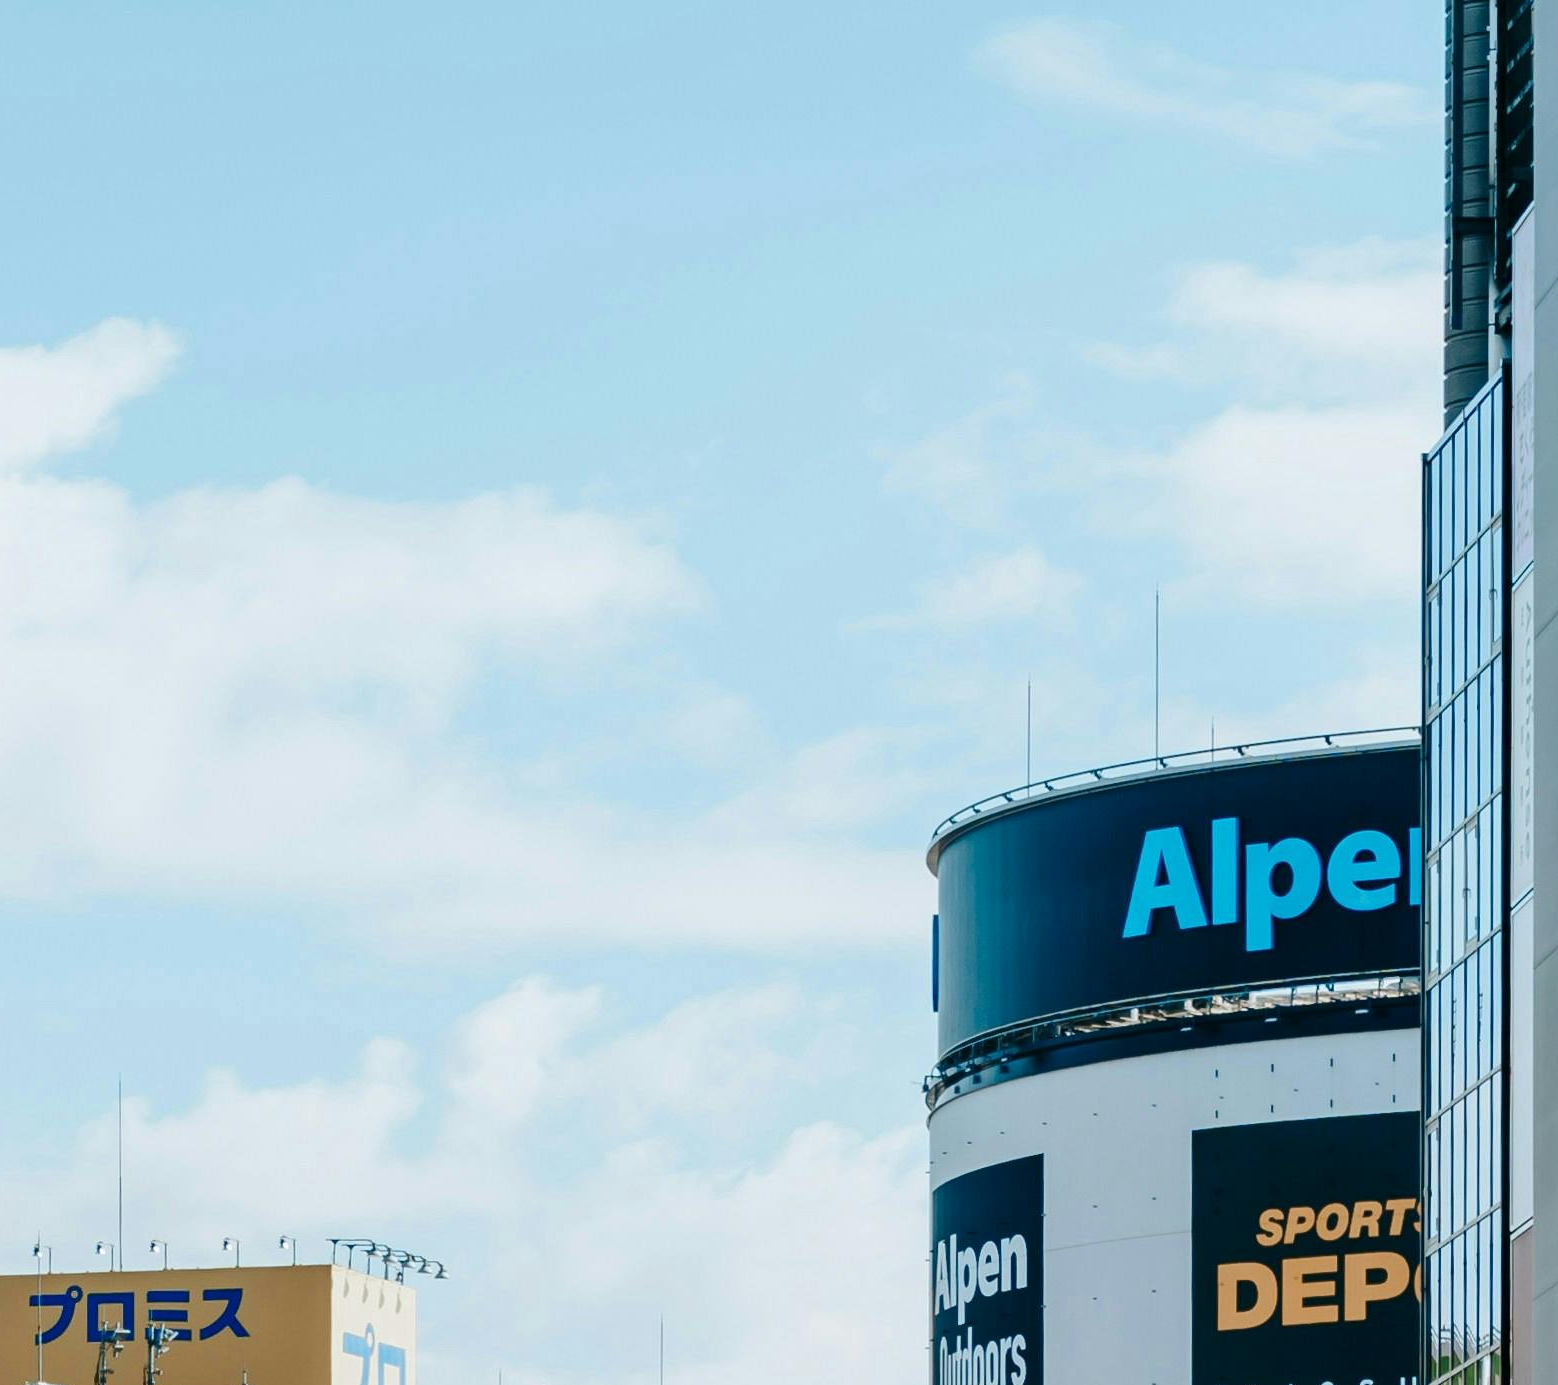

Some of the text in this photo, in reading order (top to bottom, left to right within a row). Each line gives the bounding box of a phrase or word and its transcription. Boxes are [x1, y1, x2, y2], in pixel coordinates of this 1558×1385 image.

[1122, 816, 1420, 953] Alpe
[29, 1285, 250, 1346] プロミス
[933, 1230, 1028, 1327] Alpen
[1216, 1250, 1421, 1332] DEP
